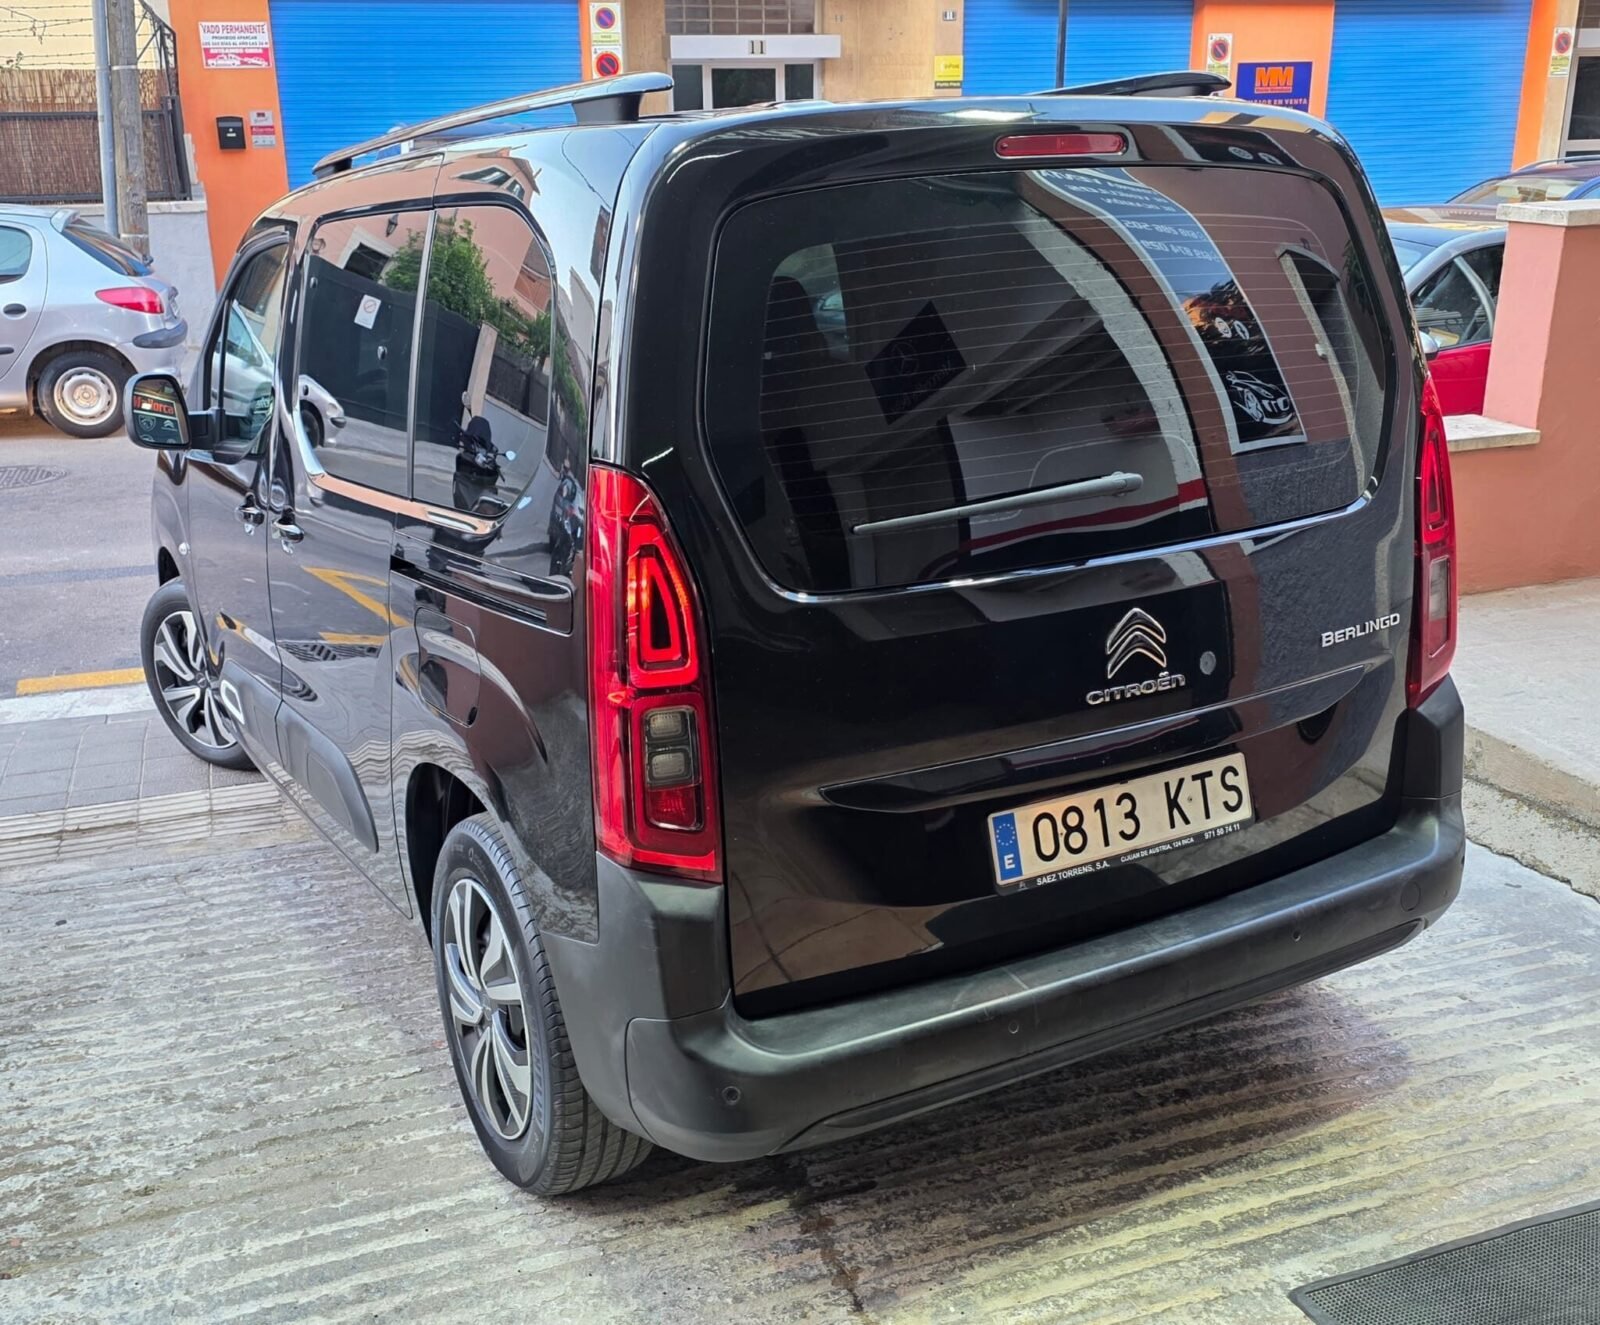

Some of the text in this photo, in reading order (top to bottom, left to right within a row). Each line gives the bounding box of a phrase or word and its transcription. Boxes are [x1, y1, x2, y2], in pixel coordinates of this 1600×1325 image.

[202, 23, 265, 34] VADO PERMANENTE
[750, 40, 765, 55] 11
[1256, 67, 1294, 87] MM
[1321, 613, 1400, 647] BERLINGO
[1032, 765, 1243, 862] 0813 KTS
[1204, 828, 1217, 840] 971
[1225, 825, 1233, 835] 74
[1233, 823, 1241, 832] 11
[1004, 854, 1015, 870] E
[1036, 875, 1057, 886] SAEZ
[1058, 864, 1095, 880] TORRENS,
[1095, 860, 1111, 870] S.A.
